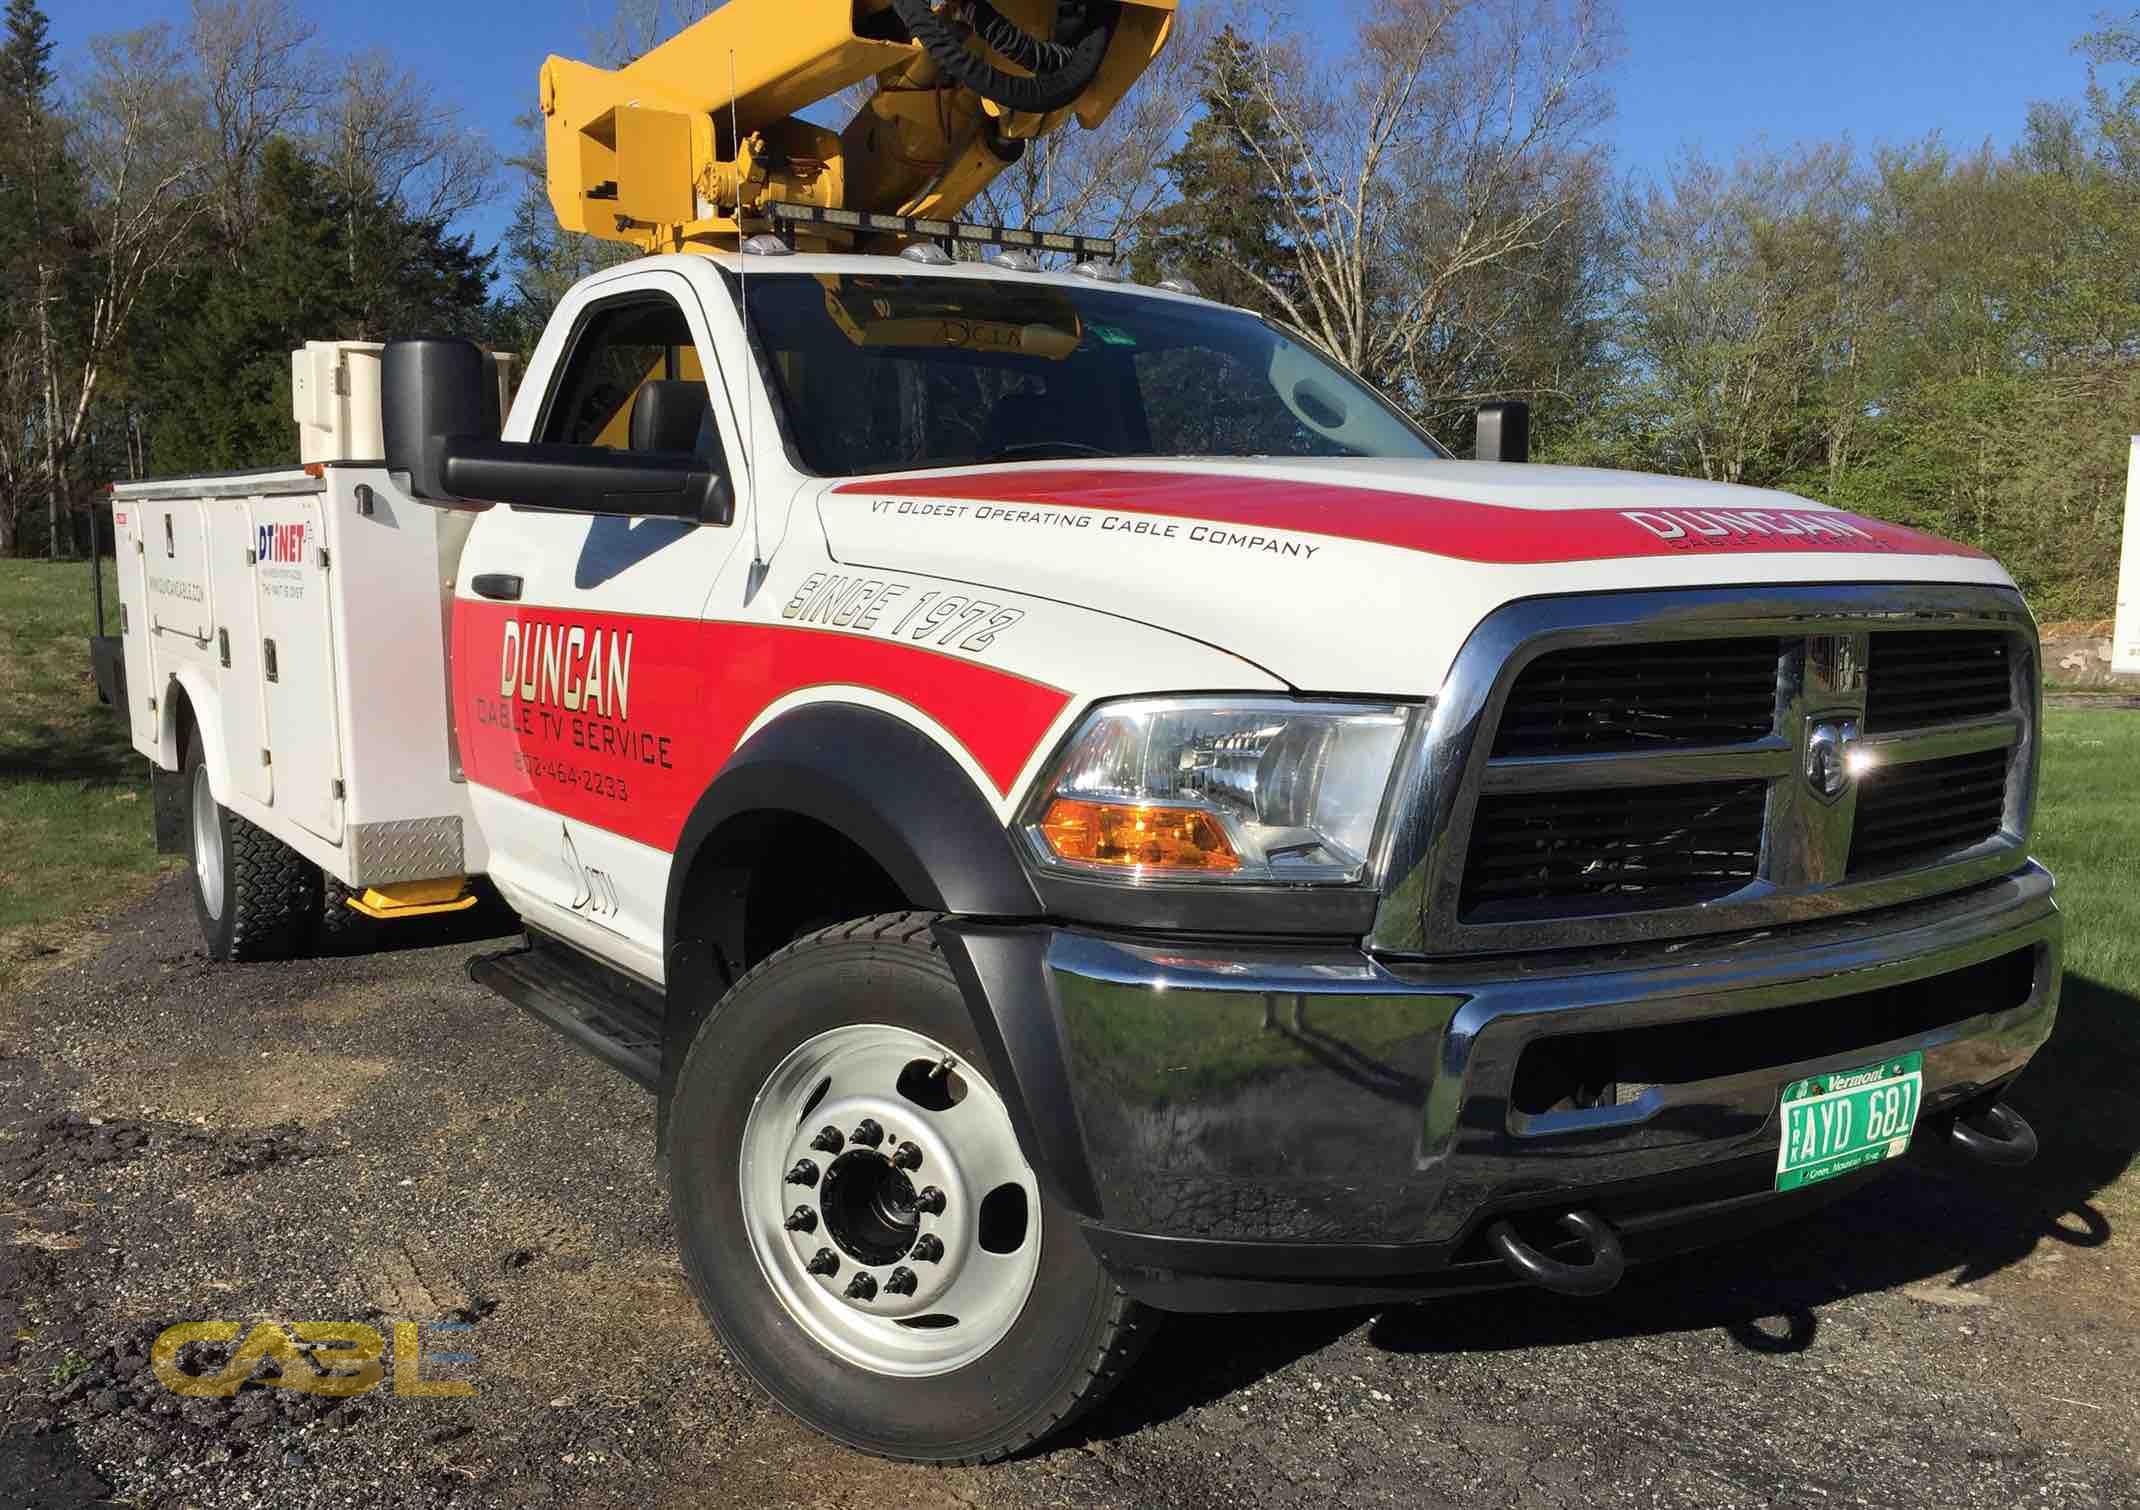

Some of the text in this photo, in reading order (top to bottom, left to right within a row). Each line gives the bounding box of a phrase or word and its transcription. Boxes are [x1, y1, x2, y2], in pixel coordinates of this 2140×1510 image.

[871, 500, 1321, 559] VT OLDEST OPERATING CABLE COMPANY
[1620, 511, 1873, 539] DUNCAN
[782, 572, 1025, 652] SINCE 1972
[500, 618, 634, 721] DUNCAN
[475, 698, 673, 769] CABLE TV SERVICE
[1828, 1065, 1885, 1092] Vermont
[1801, 1082, 1912, 1160] AYD 681
